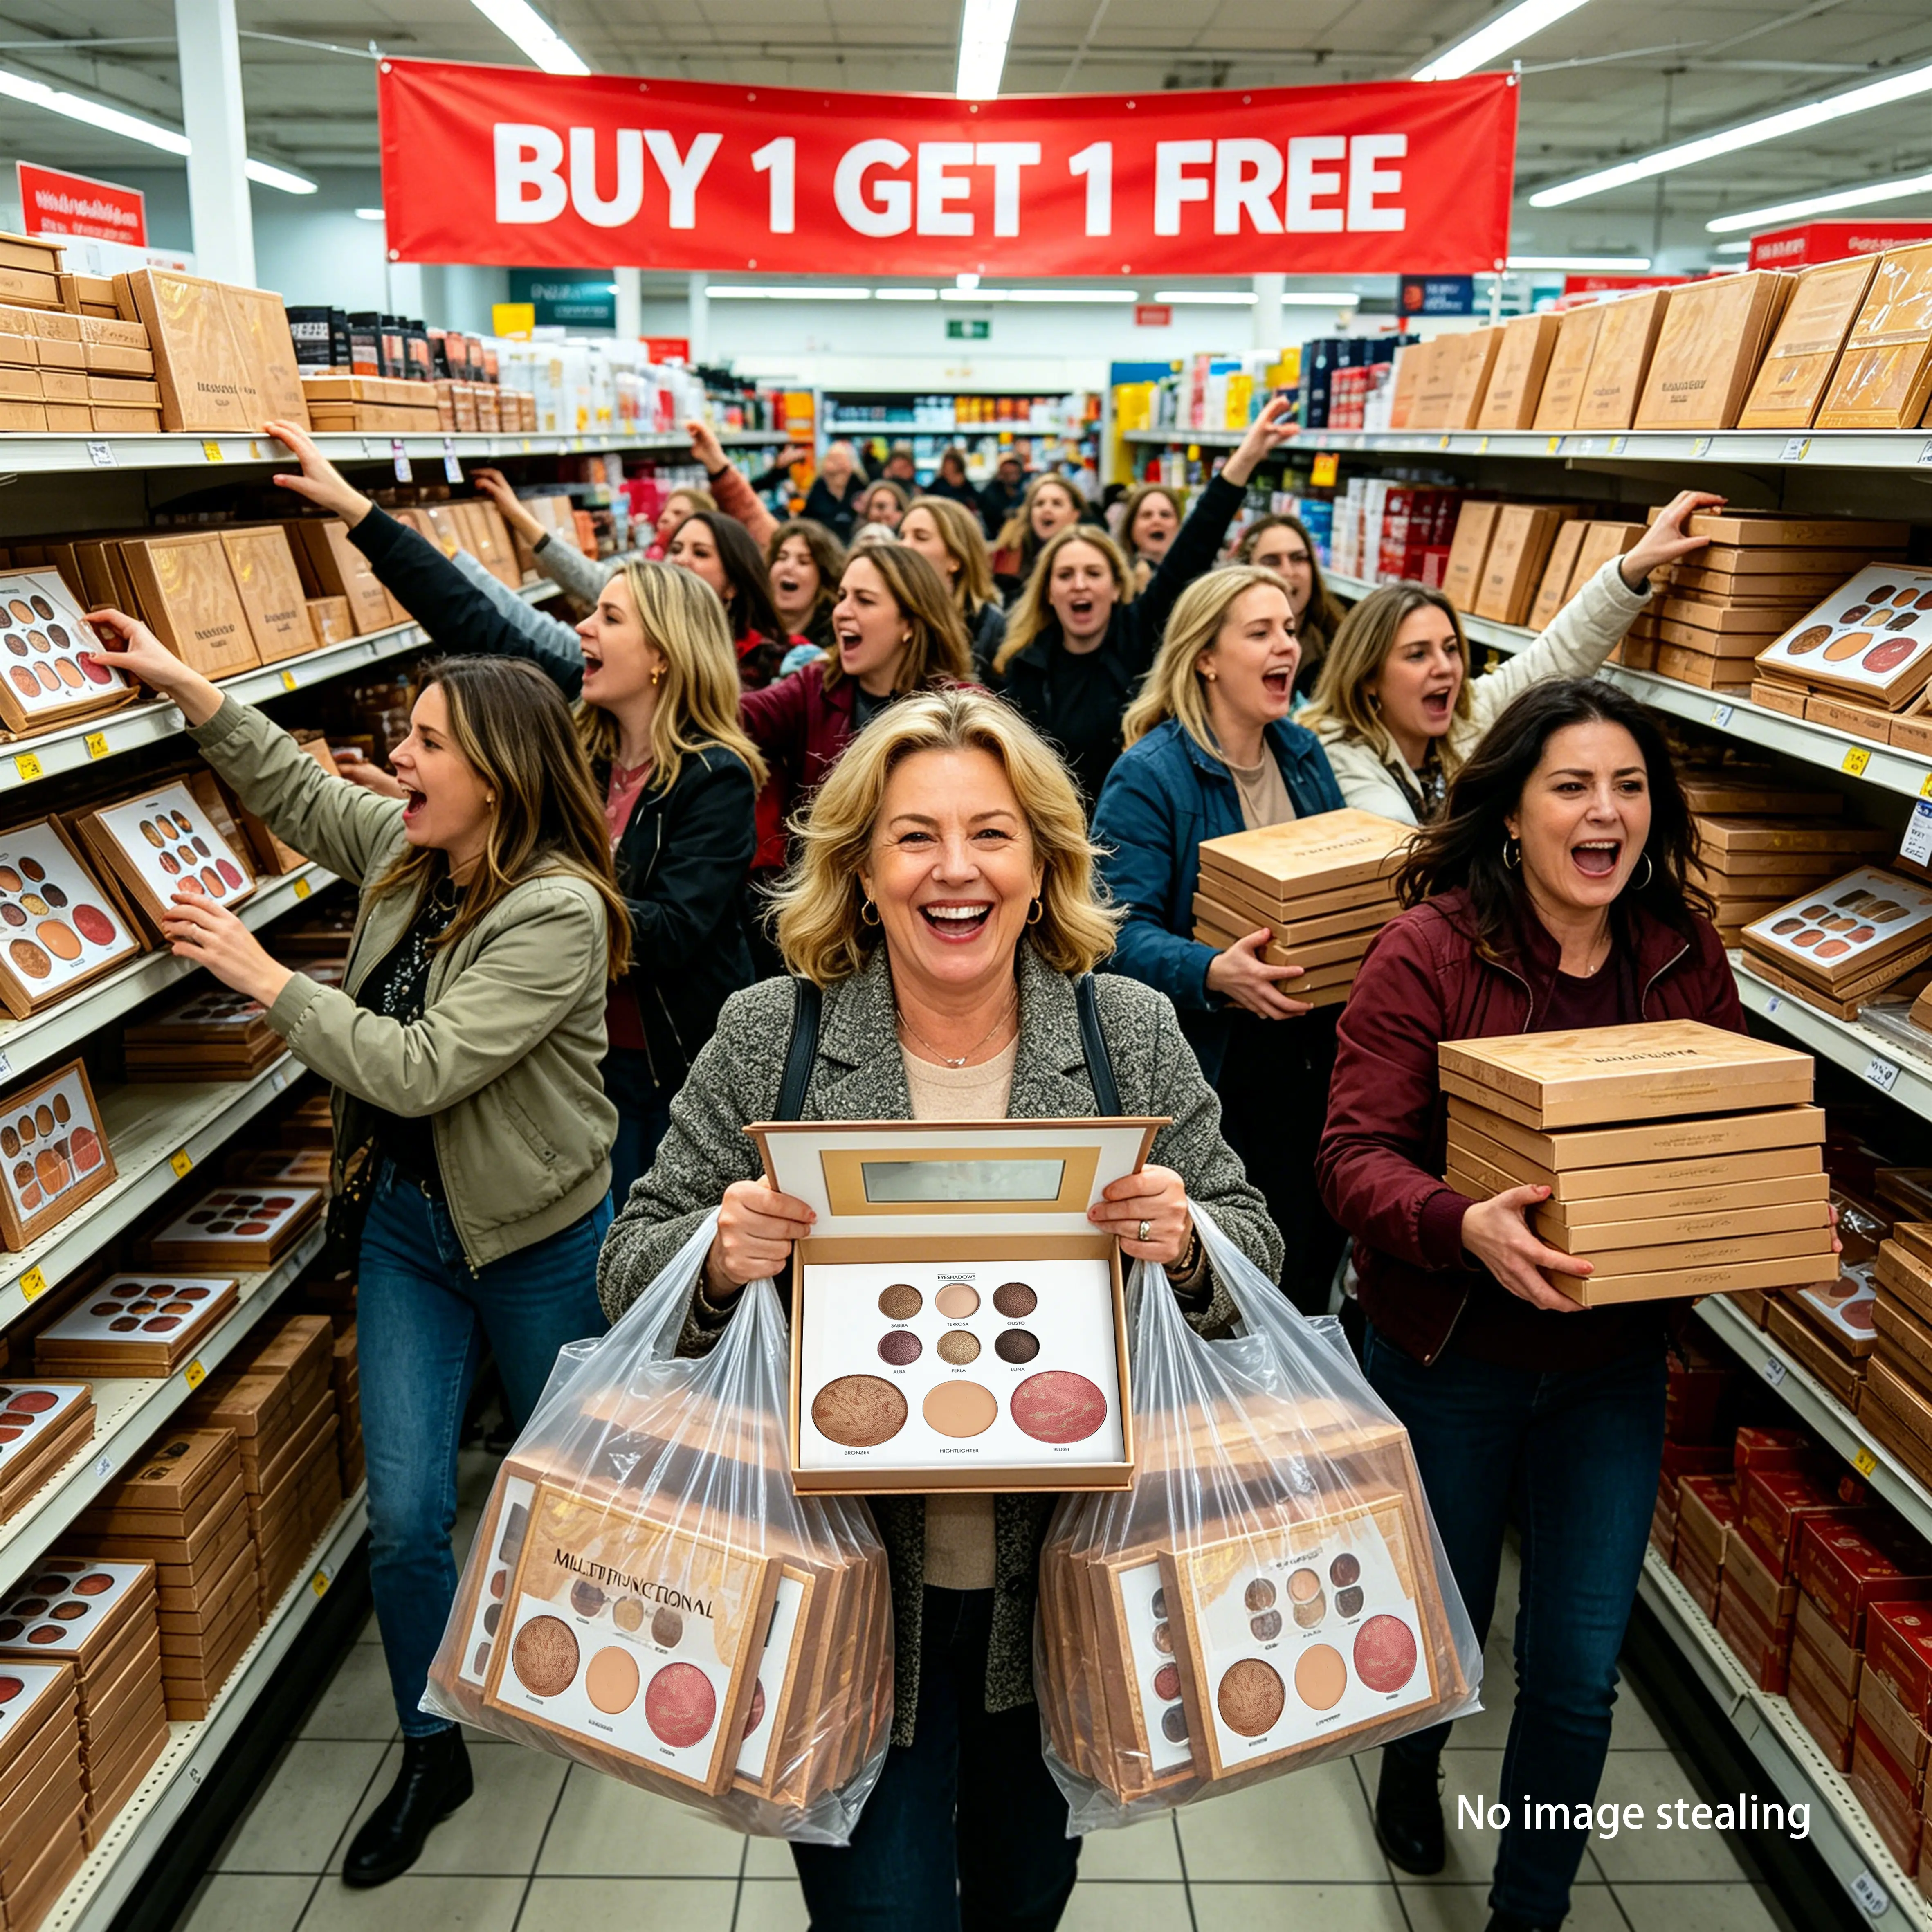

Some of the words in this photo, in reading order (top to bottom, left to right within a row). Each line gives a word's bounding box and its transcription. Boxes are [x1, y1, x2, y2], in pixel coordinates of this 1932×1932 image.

[493, 123, 722, 229] BUY
[751, 137, 795, 234] 1
[834, 139, 1041, 238] GET
[1068, 142, 1112, 237] 1
[1154, 134, 1407, 236] FREE
